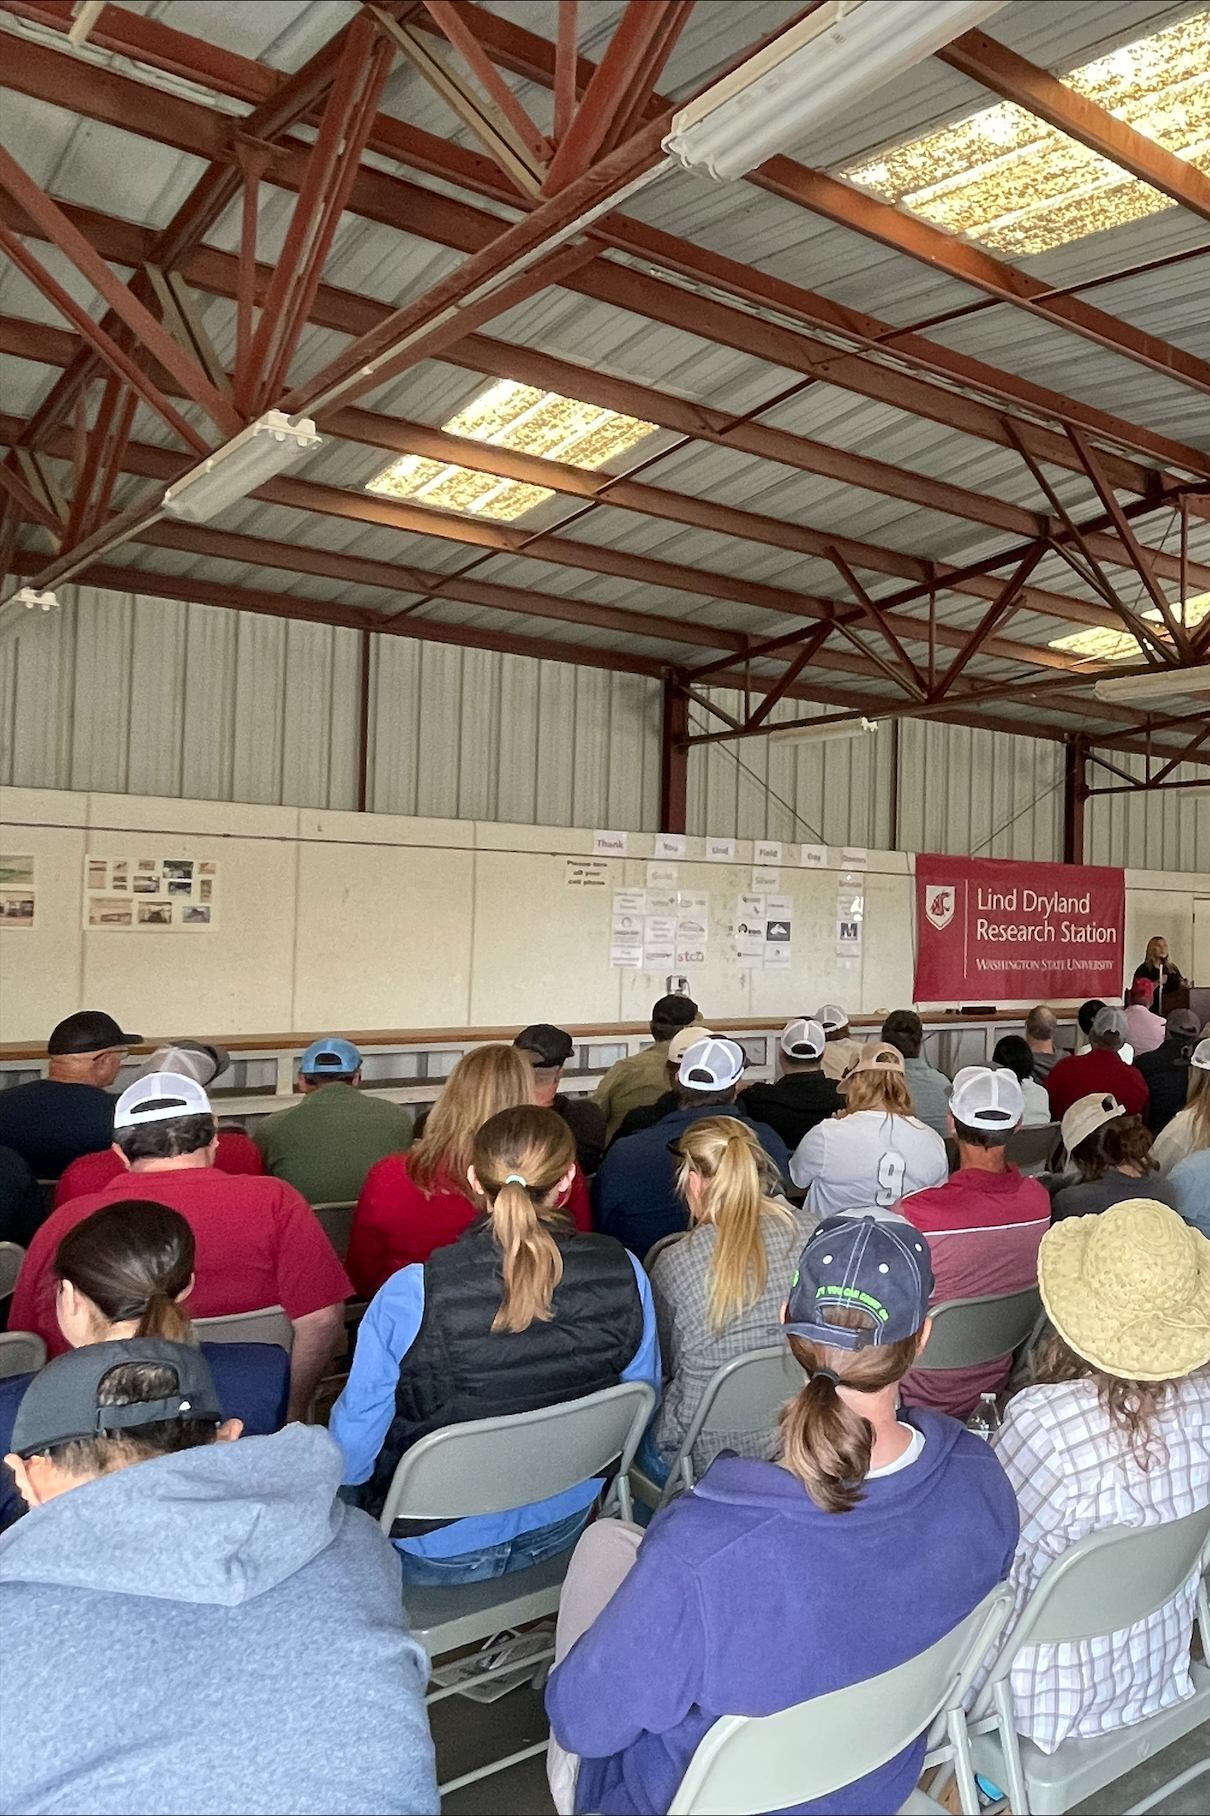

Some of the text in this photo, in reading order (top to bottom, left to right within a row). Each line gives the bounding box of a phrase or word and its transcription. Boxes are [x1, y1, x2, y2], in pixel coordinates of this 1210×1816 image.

[597, 839, 624, 849] Thank
[663, 843, 679, 852] You
[759, 848, 778, 858] Field
[978, 887, 1091, 919] Lind Dryland
[976, 918, 1117, 943] Research Station
[976, 958, 1115, 971] WASHINGTON STATE UNIVERSITY
[875, 1151, 906, 1206] 9
